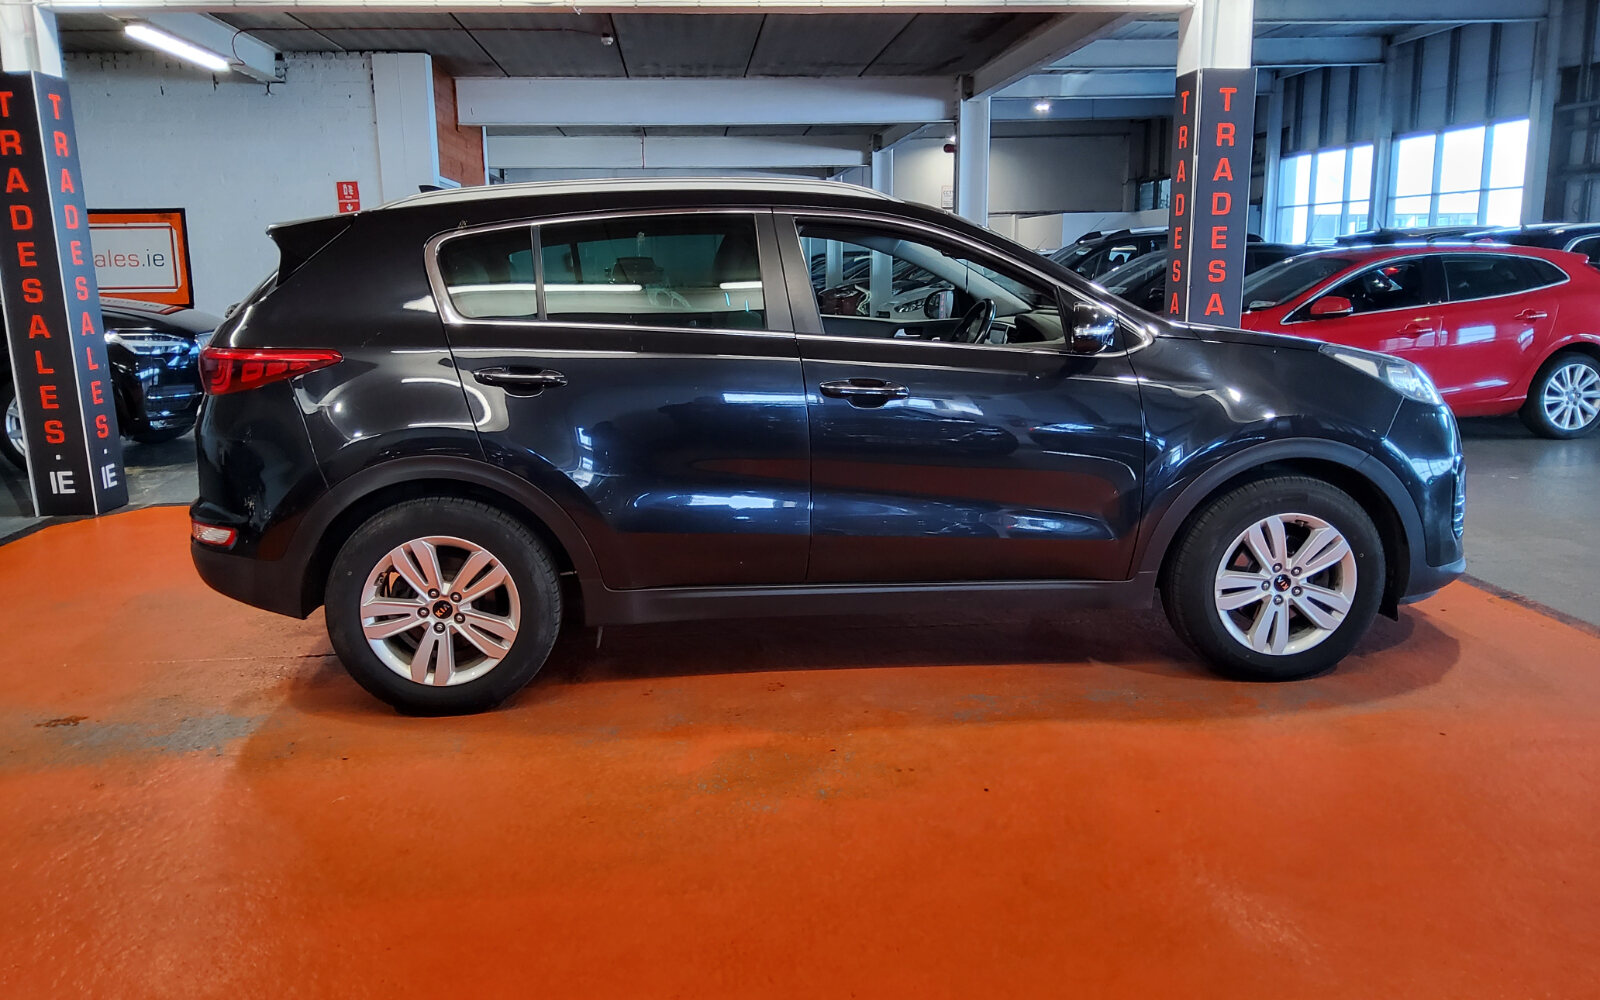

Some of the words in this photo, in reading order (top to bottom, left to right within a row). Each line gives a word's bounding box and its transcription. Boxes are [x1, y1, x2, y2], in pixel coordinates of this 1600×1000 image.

[94, 249, 165, 268] ales.ie
[1169, 90, 1190, 315] TRADESA
[1204, 87, 1238, 316] TRADESA
